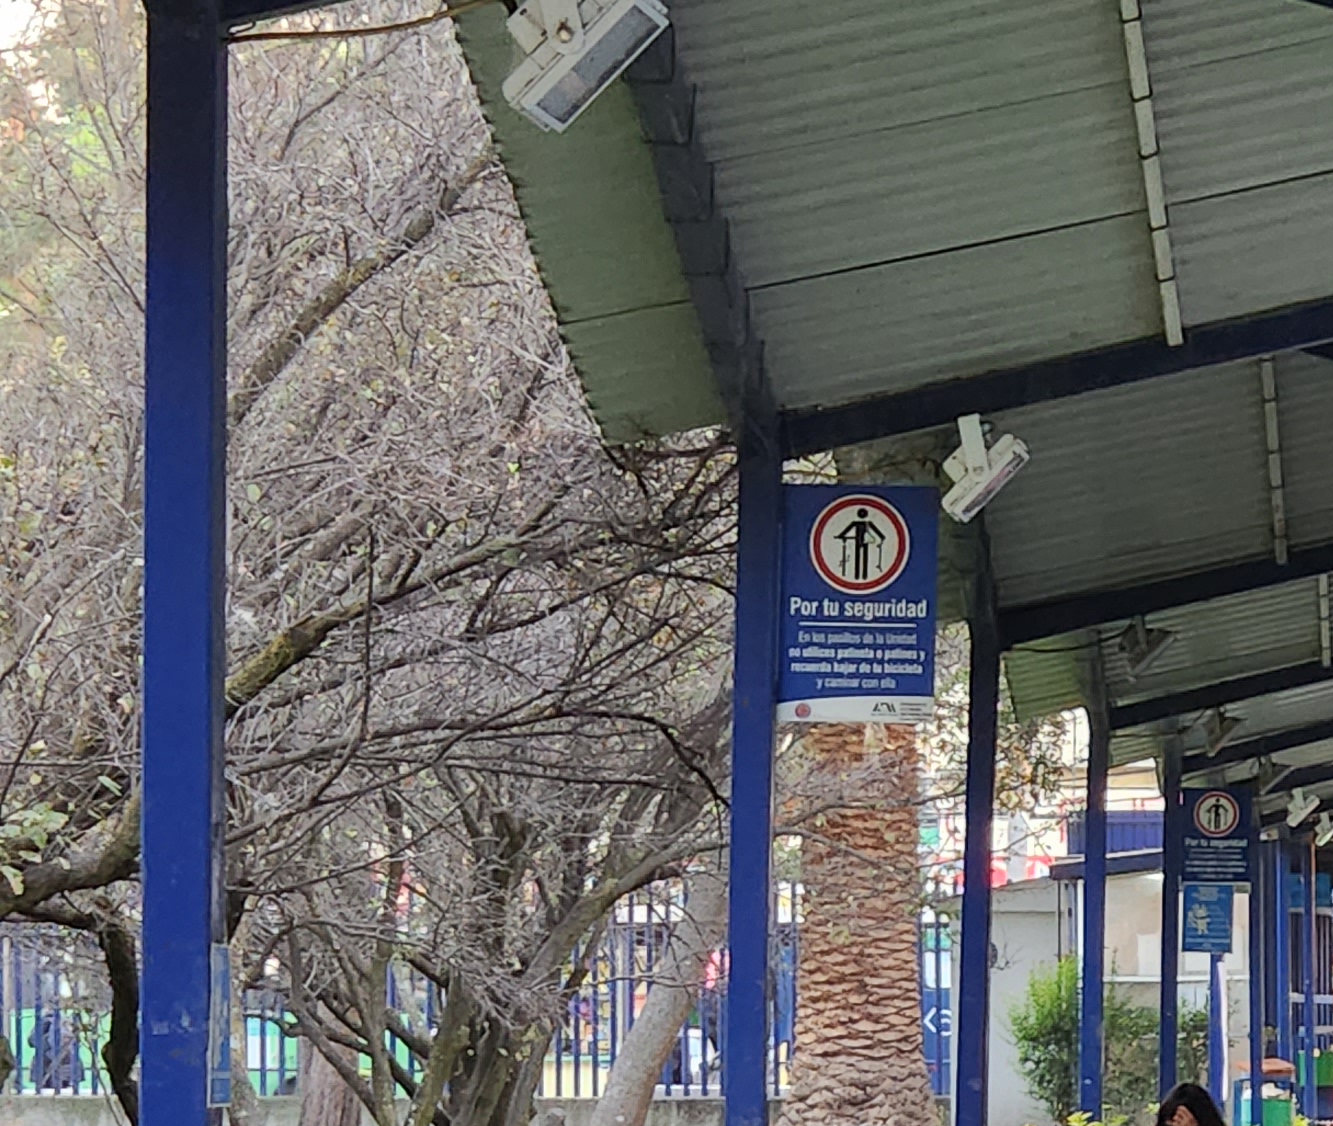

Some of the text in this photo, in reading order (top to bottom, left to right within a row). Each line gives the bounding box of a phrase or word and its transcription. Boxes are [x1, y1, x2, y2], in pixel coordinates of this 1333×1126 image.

[790, 597, 927, 620] Por tu seguridad
